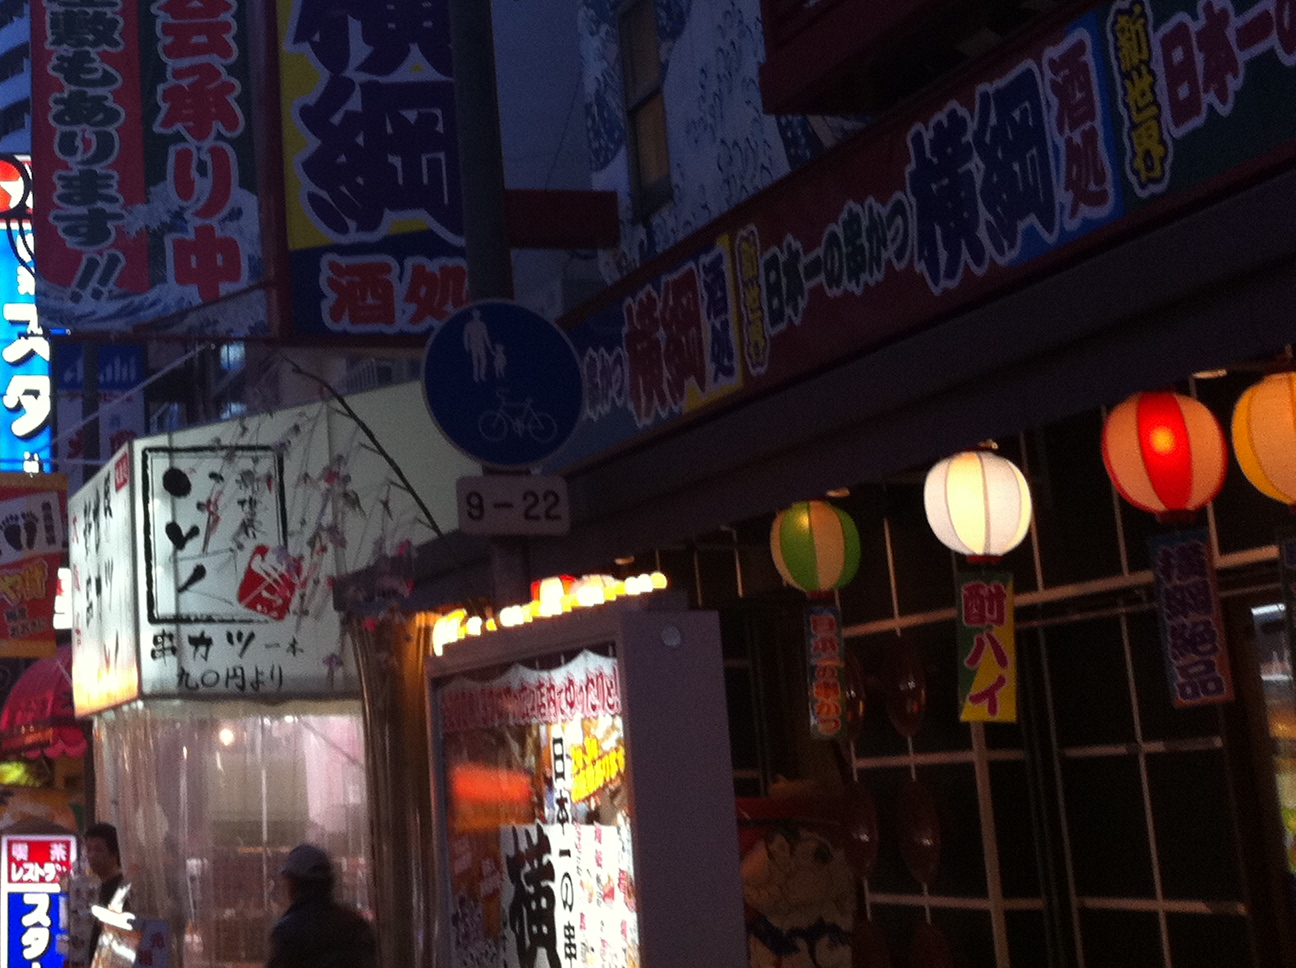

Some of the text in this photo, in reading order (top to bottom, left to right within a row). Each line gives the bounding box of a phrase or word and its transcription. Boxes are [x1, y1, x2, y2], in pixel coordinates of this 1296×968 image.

[1050, 31, 1113, 231] 酒処
[326, 260, 467, 329] 酒処
[960, 580, 1009, 717] 酎ハイ
[21, 892, 52, 968] スタ
